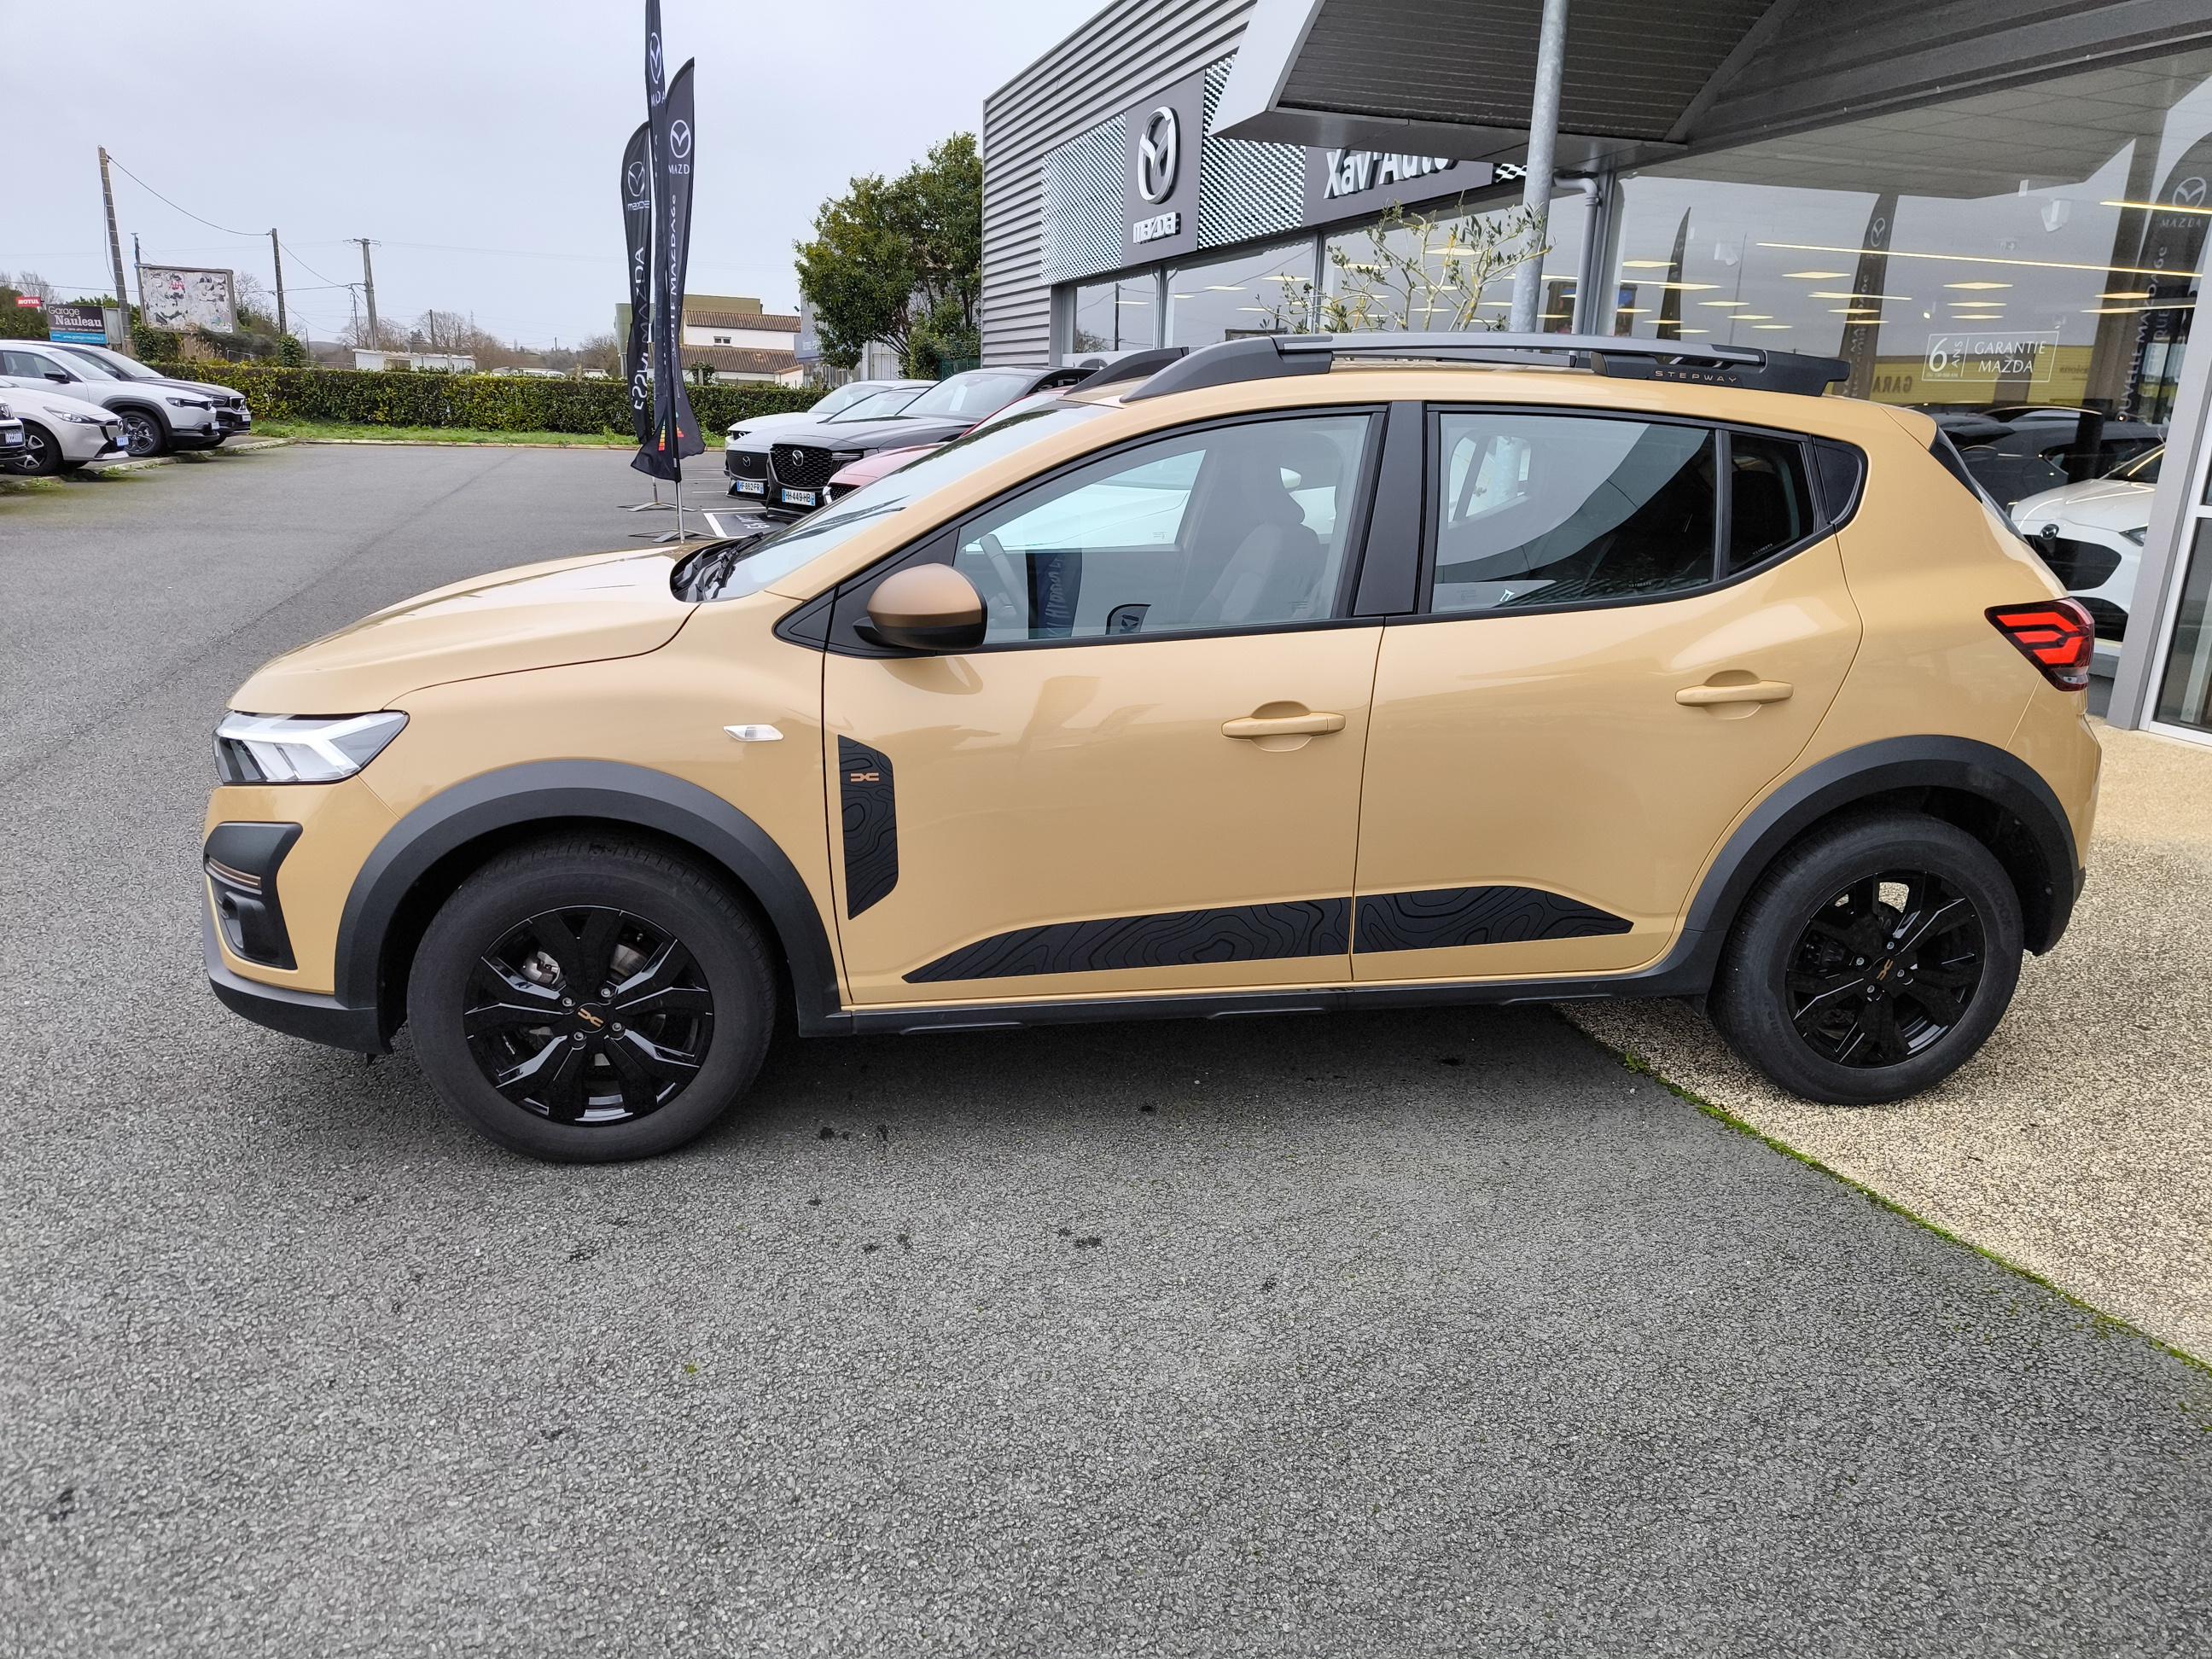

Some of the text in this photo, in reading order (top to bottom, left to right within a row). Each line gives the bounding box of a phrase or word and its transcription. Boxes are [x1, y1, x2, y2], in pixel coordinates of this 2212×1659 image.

[668, 164, 690, 174] MAZD
[48, 306, 80, 317] Garage
[54, 315, 102, 327] Nauleau
[1974, 341, 2047, 354] GARANTIE
[1929, 337, 1964, 372] 6 ANS
[1978, 359, 2034, 373] MAZDA
[1656, 370, 1737, 383] STEPWAY
